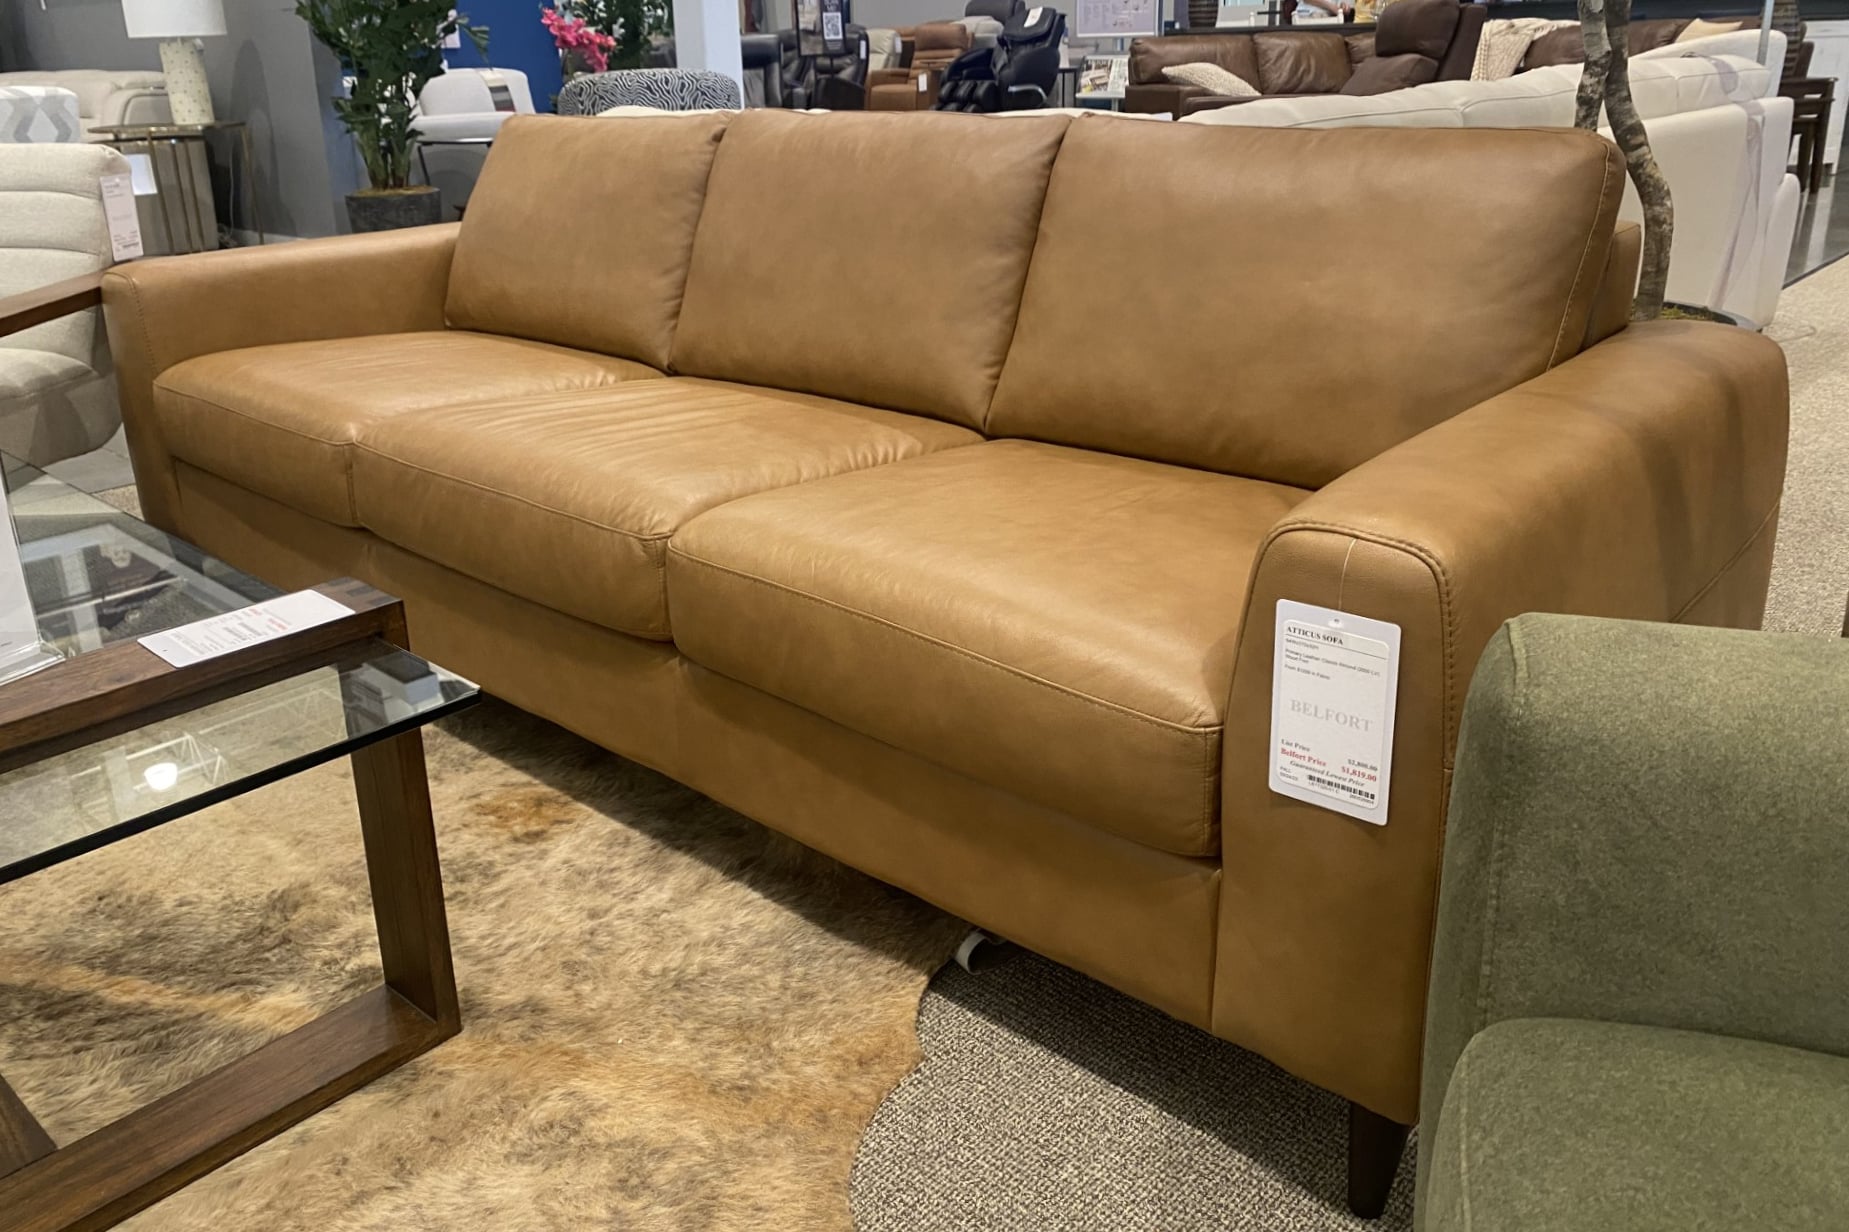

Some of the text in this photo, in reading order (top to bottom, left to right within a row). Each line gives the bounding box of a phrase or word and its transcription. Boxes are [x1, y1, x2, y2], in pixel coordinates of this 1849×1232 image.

[1286, 626, 1321, 640] ATTICUS
[1322, 634, 1344, 646] SOFA
[1290, 699, 1374, 732] BELFORT
[1280, 747, 1327, 767] Belfort Price
[1295, 742, 1311, 752] Price
[1290, 760, 1325, 775] Guaranteed
[1348, 777, 1365, 787] Price
[1341, 765, 1377, 782] $1,819.00
